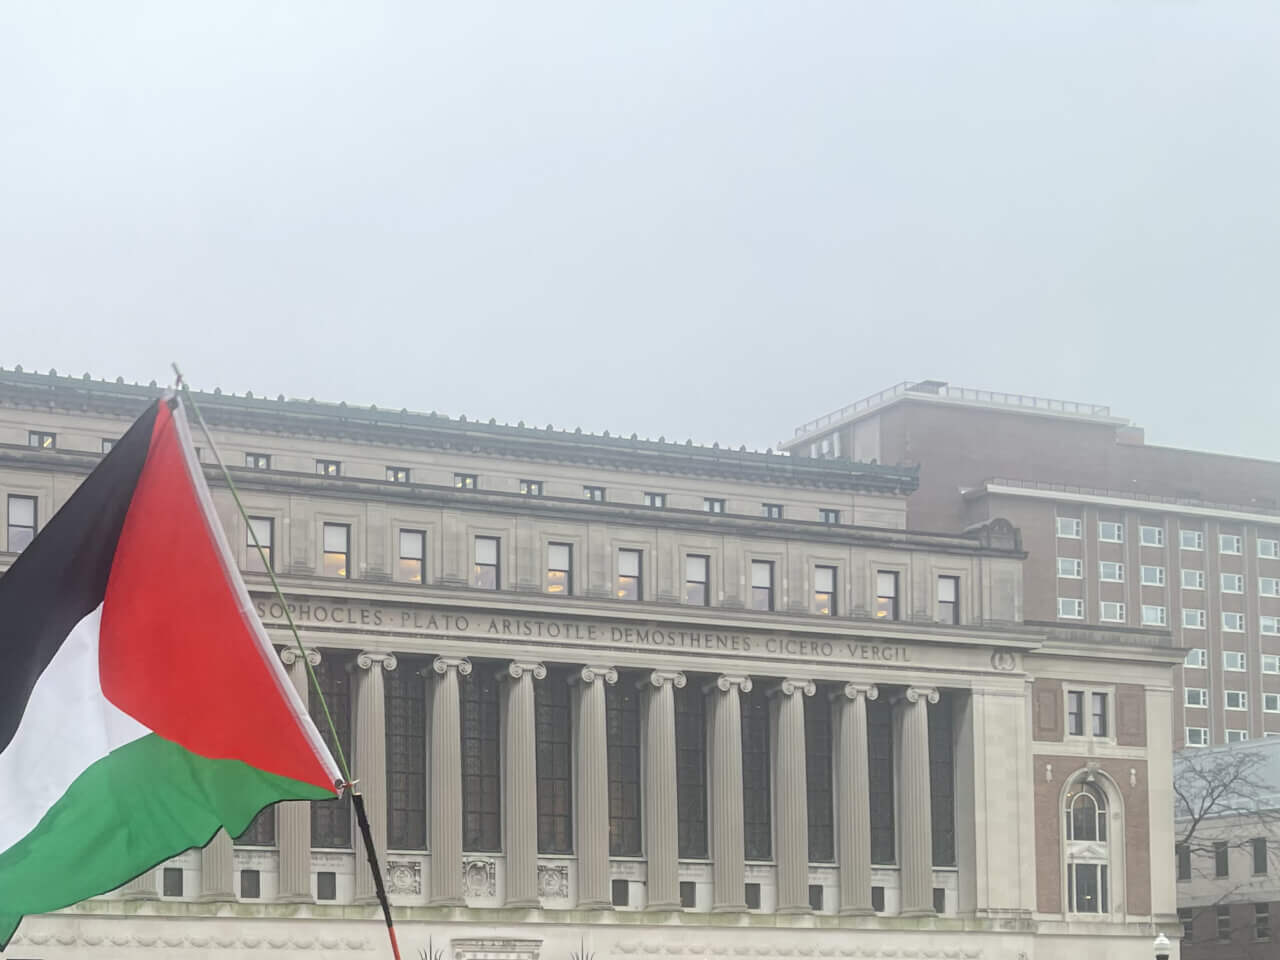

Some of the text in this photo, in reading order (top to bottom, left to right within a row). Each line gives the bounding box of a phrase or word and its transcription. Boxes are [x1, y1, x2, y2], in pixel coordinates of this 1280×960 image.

[257, 602, 912, 663] SOPHOCLES PLATO ARISTOTLE DEMOSTHENES CICERO VERGIL
